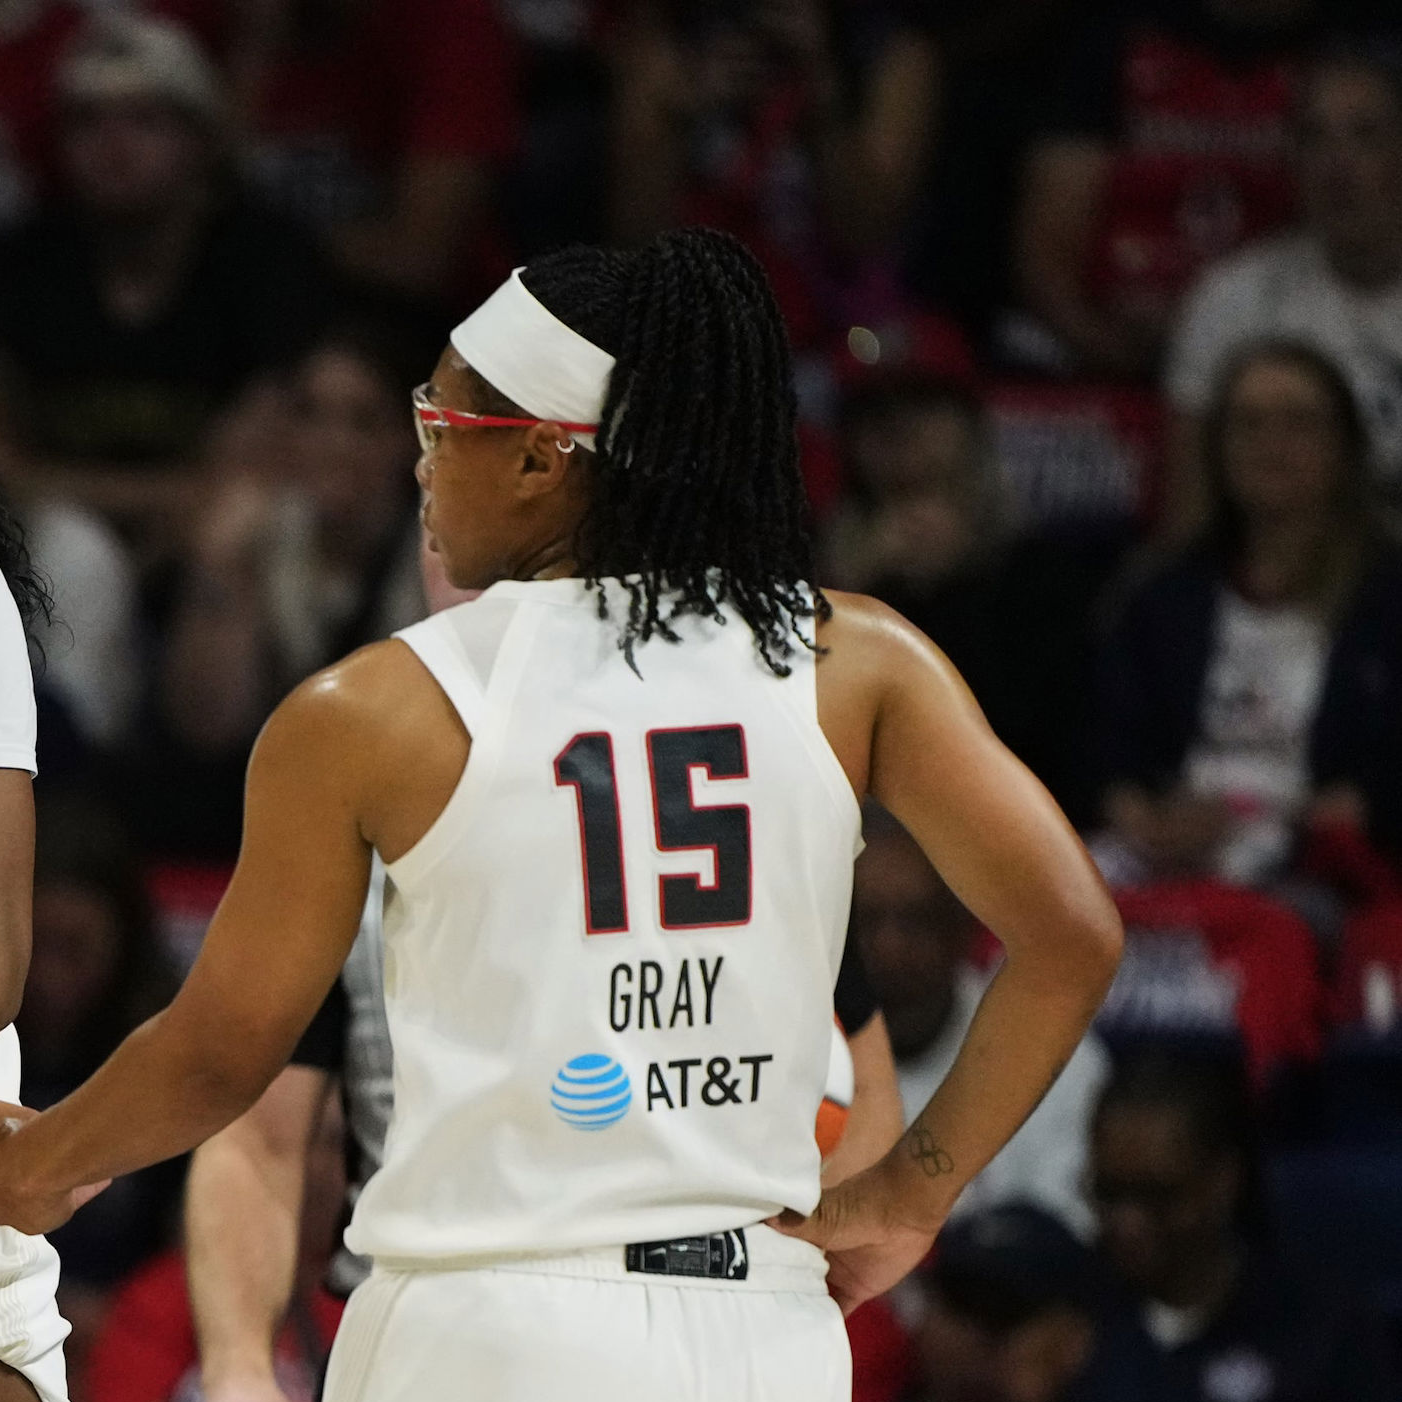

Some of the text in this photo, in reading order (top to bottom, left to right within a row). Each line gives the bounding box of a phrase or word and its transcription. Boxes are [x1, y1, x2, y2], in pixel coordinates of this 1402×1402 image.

[552, 723, 753, 936] 15
[609, 956, 724, 1033] GRAY
[646, 1054, 773, 1112] AT&T
